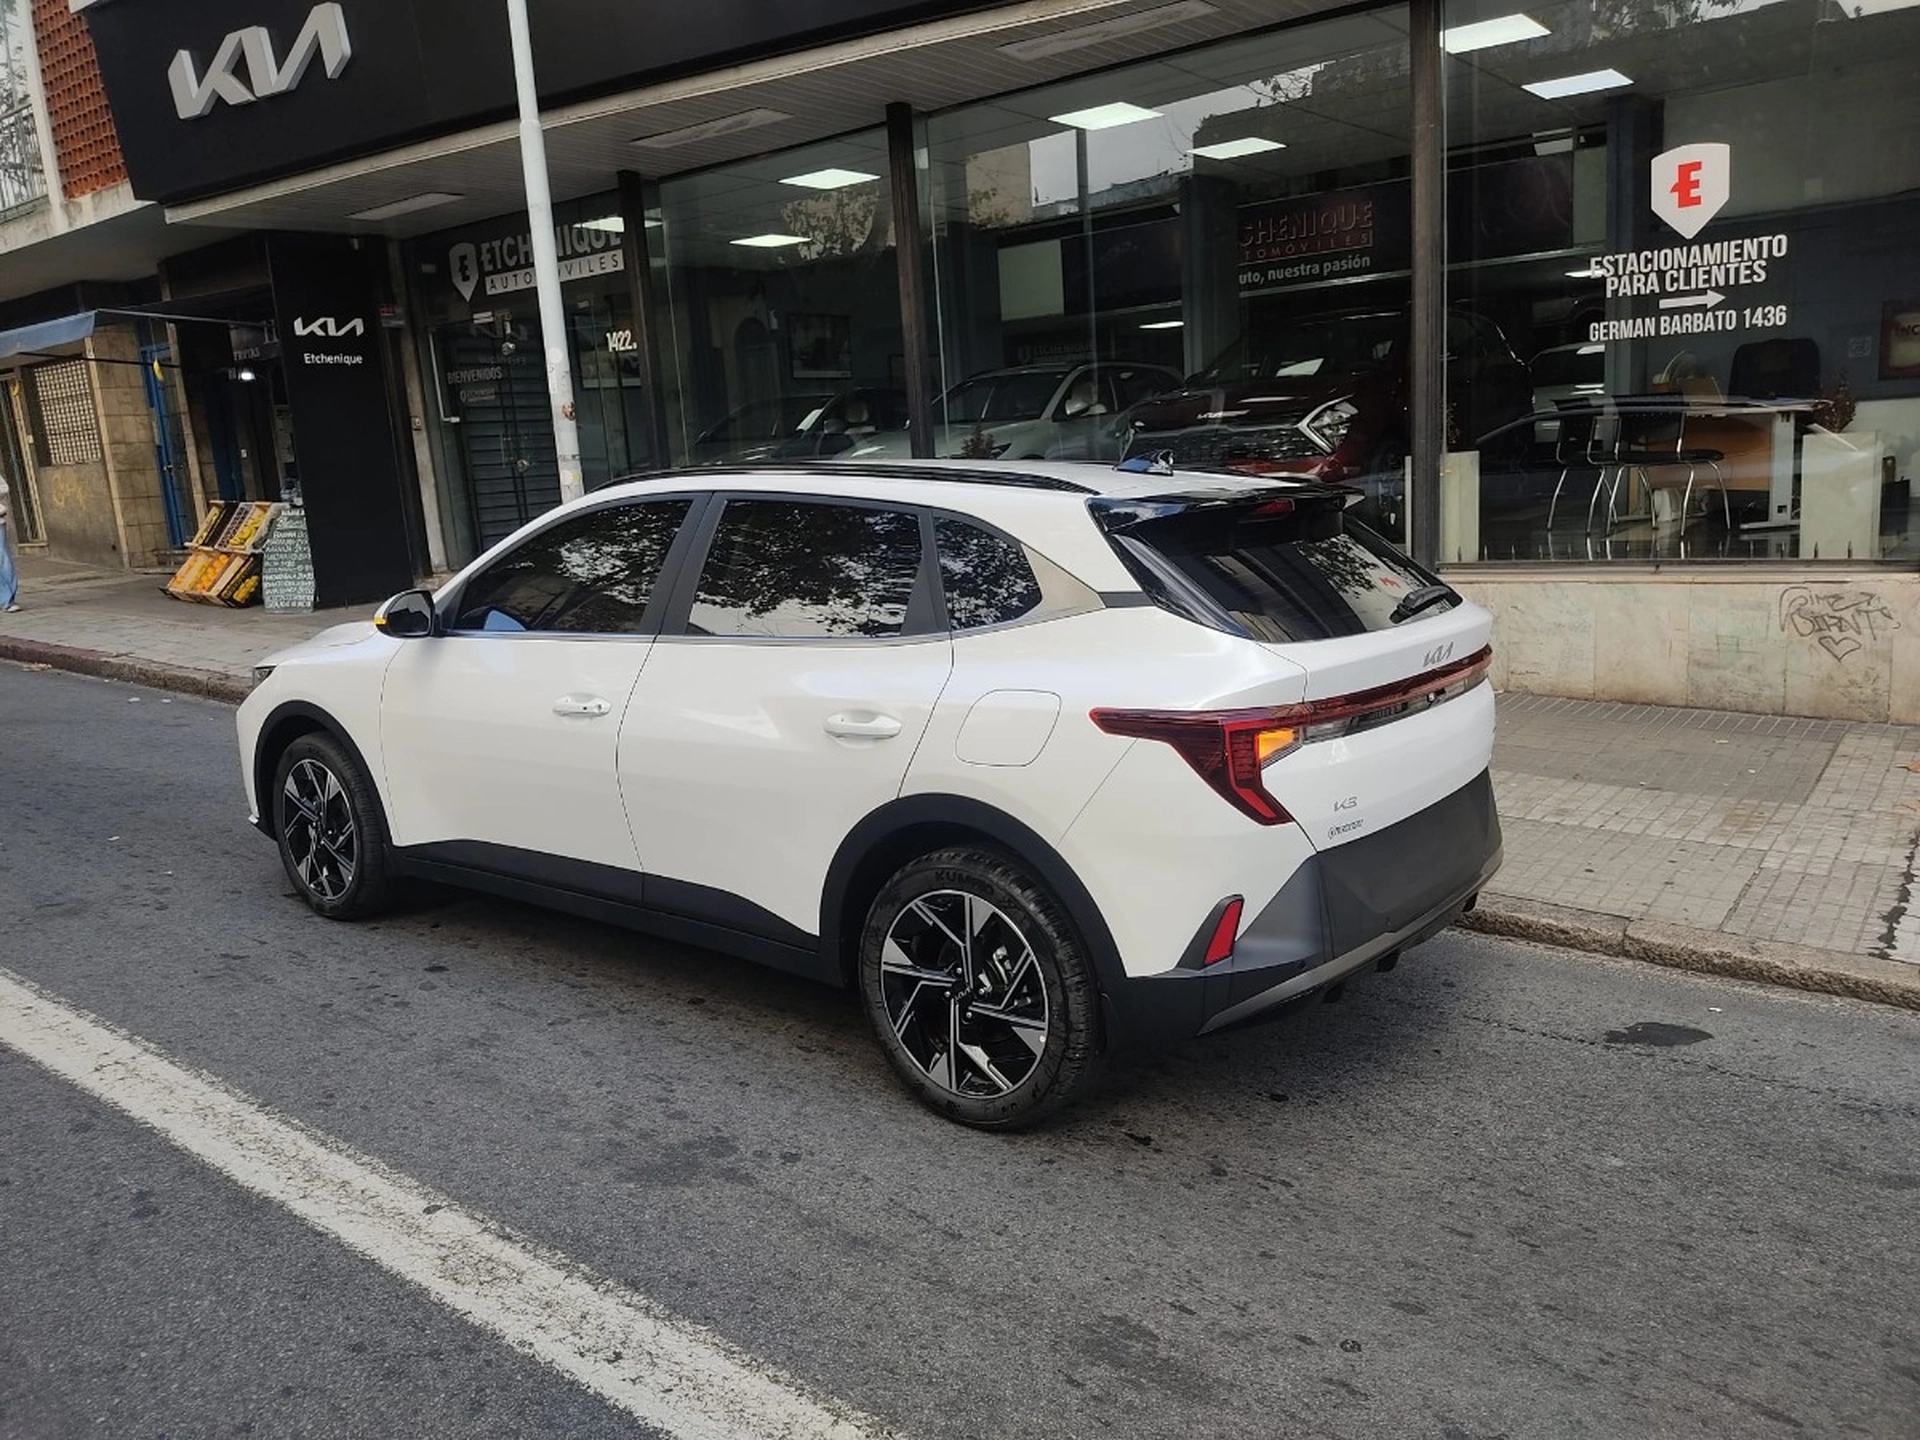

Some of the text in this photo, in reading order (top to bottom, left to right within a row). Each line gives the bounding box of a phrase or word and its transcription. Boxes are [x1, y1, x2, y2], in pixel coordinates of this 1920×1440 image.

[168, 2, 351, 119] KIA
[489, 254, 618, 291] AUTOVILES
[1268, 263, 1319, 280] nuestra
[1323, 254, 1370, 276] pasión
[1590, 234, 1788, 278] ESTACIONAMIENTO
[1606, 260, 1767, 298] PARA CLIENTES
[294, 317, 364, 336] KIA
[1589, 305, 1787, 341] GERMAN BARBATO 1436
[303, 353, 363, 365] Etchenique
[1334, 796, 1357, 811] K3
